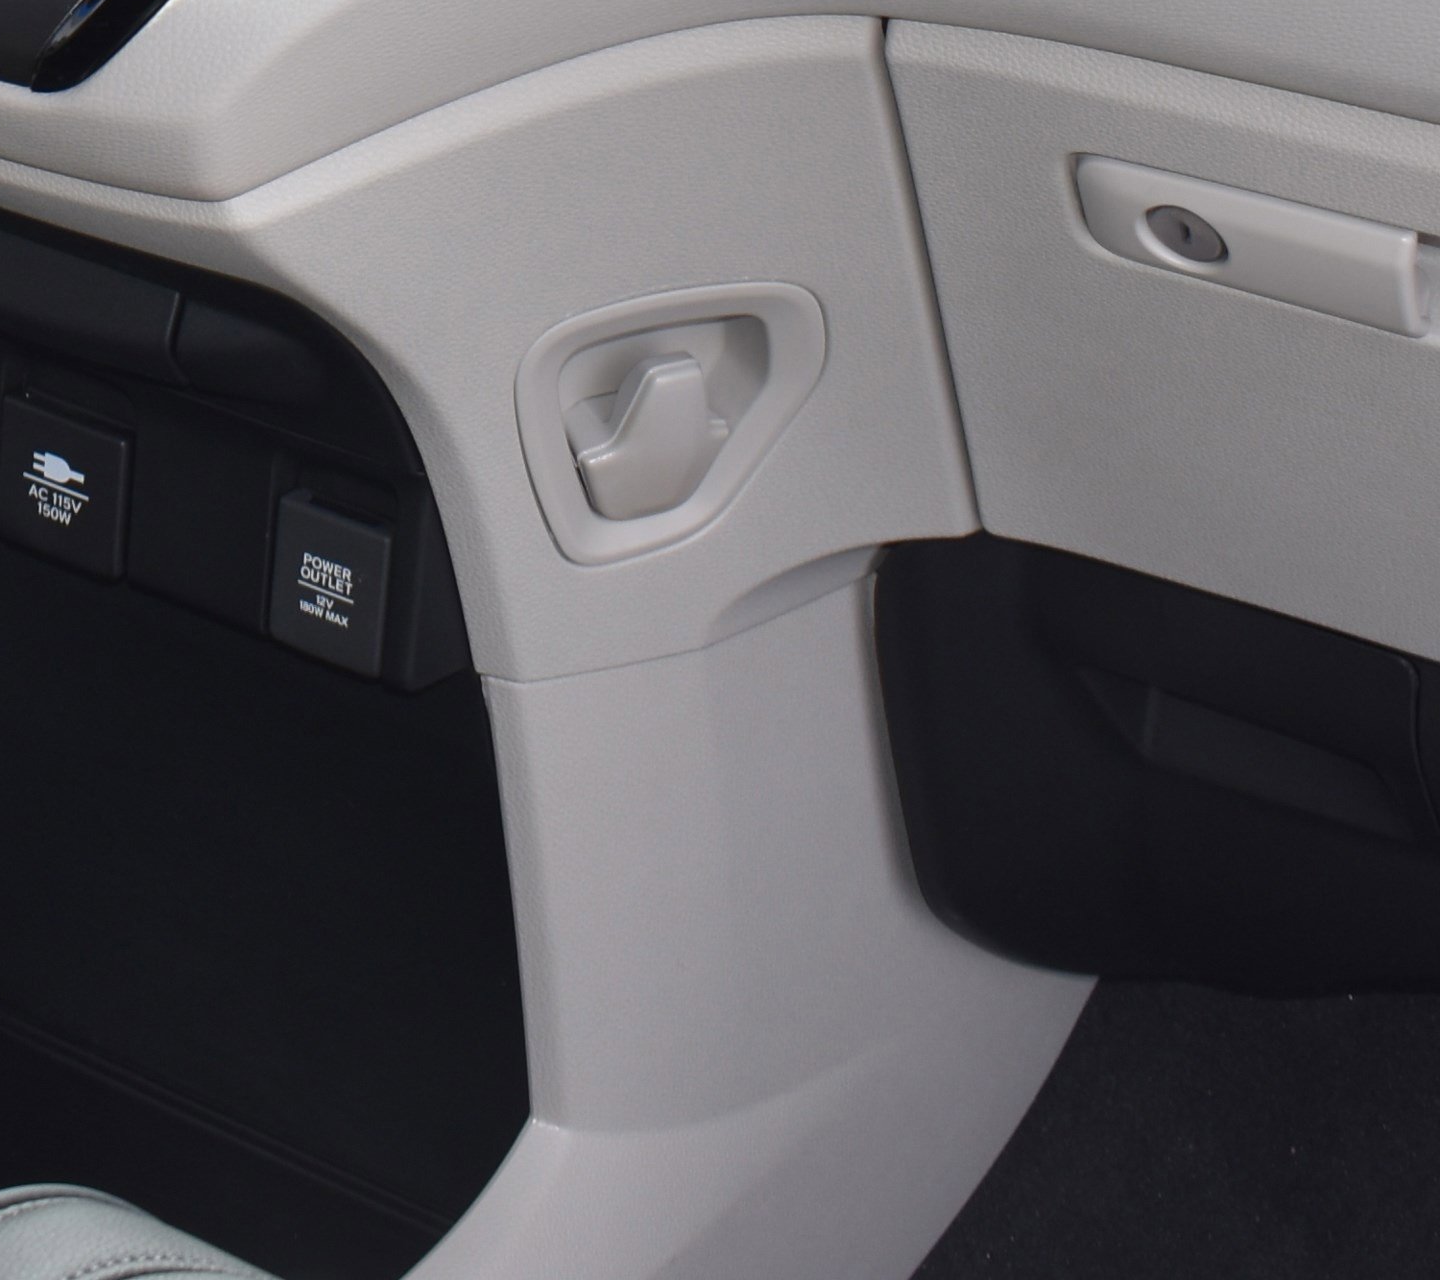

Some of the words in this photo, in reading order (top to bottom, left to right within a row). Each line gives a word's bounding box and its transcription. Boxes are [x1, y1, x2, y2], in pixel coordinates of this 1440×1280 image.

[28, 483, 49, 502] AC
[52, 492, 82, 515] 115V
[37, 501, 72, 526] 150W
[300, 565, 353, 596] OUTLET
[303, 552, 352, 582] POWER
[316, 594, 334, 610] 12V
[325, 609, 349, 628] MAX
